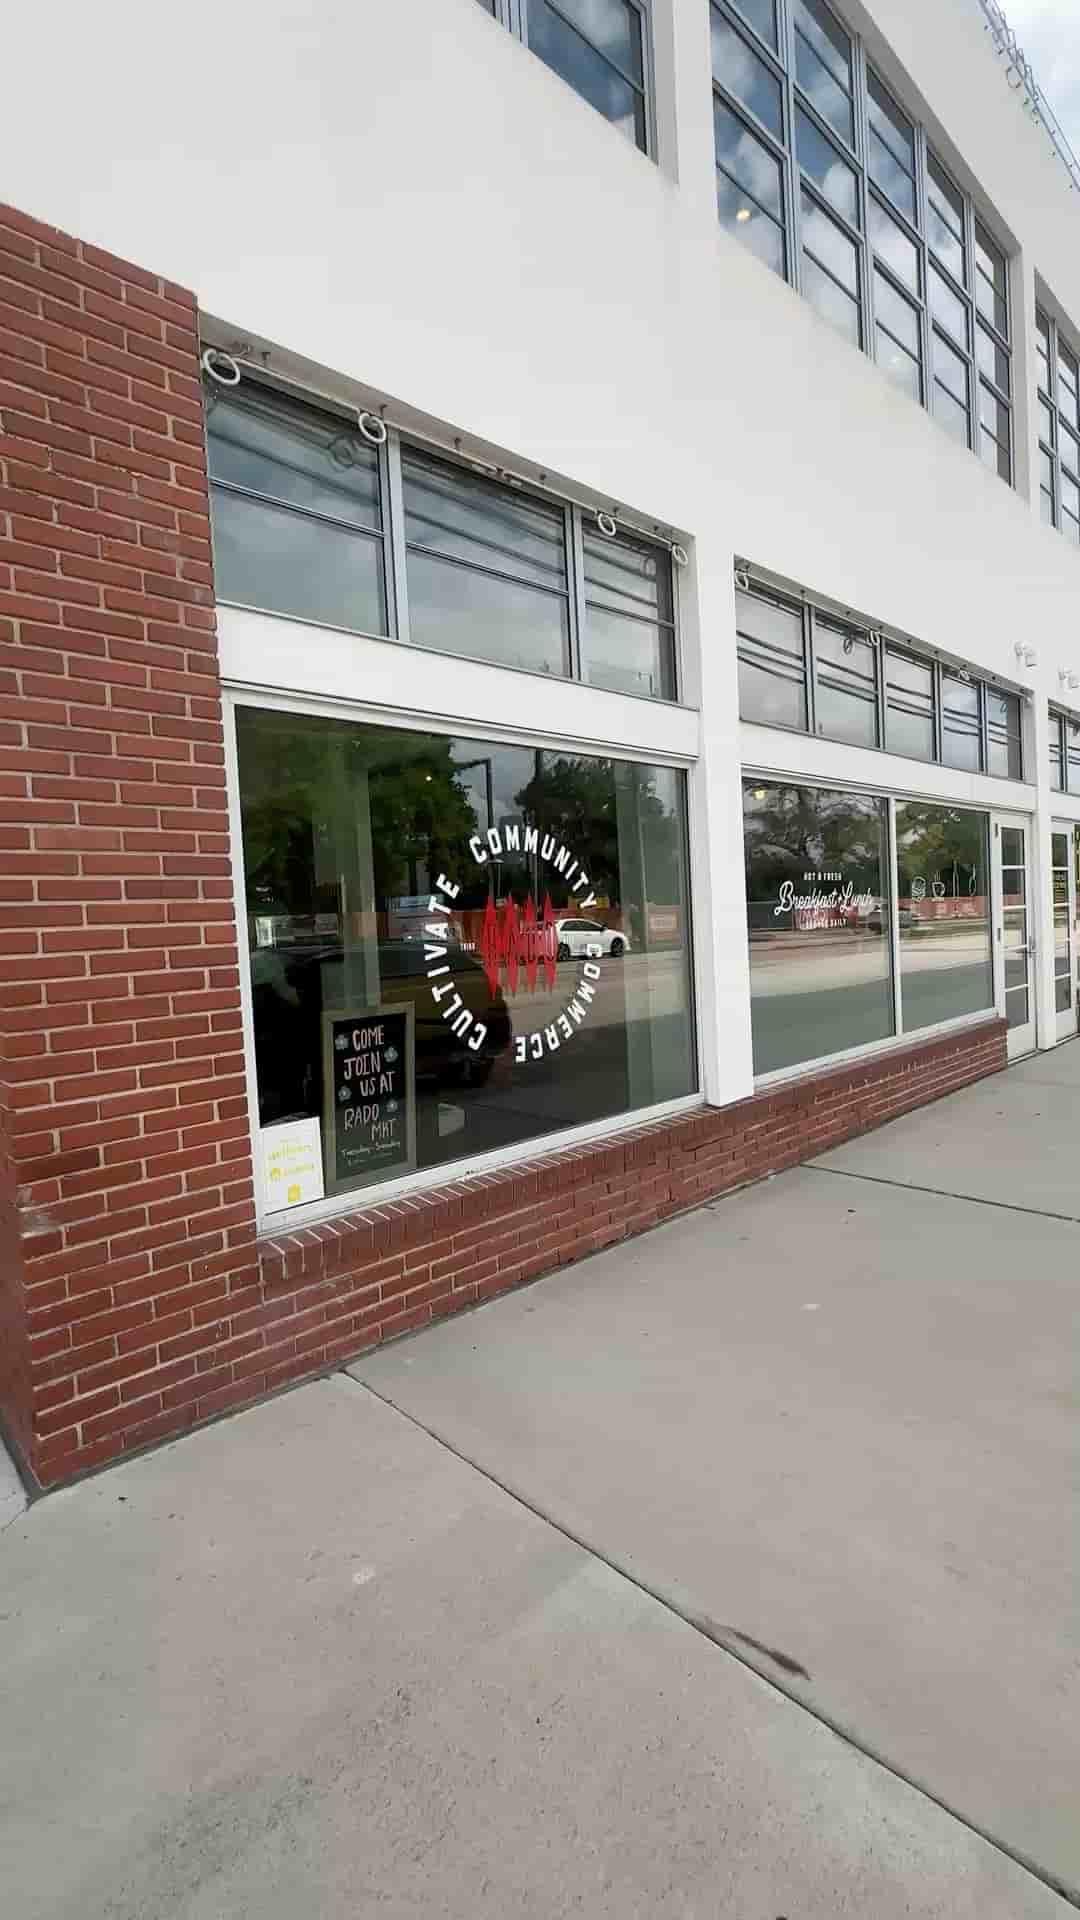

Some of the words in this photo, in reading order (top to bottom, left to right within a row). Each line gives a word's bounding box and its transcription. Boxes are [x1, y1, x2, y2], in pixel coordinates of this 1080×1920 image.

[469, 825, 598, 909] COMMUNITY
[774, 881, 837, 915] Breakfast
[840, 881, 872, 912] Lunch
[424, 873, 488, 1050] CULTIVATE
[515, 943, 601, 1063] COMMERCE
[352, 1025, 385, 1050] COME
[344, 1051, 381, 1080] JOIN
[360, 1077, 376, 1096] US
[379, 1071, 395, 1093] AT
[344, 1103, 380, 1131] RADO
[371, 1118, 397, 1141] MKT
